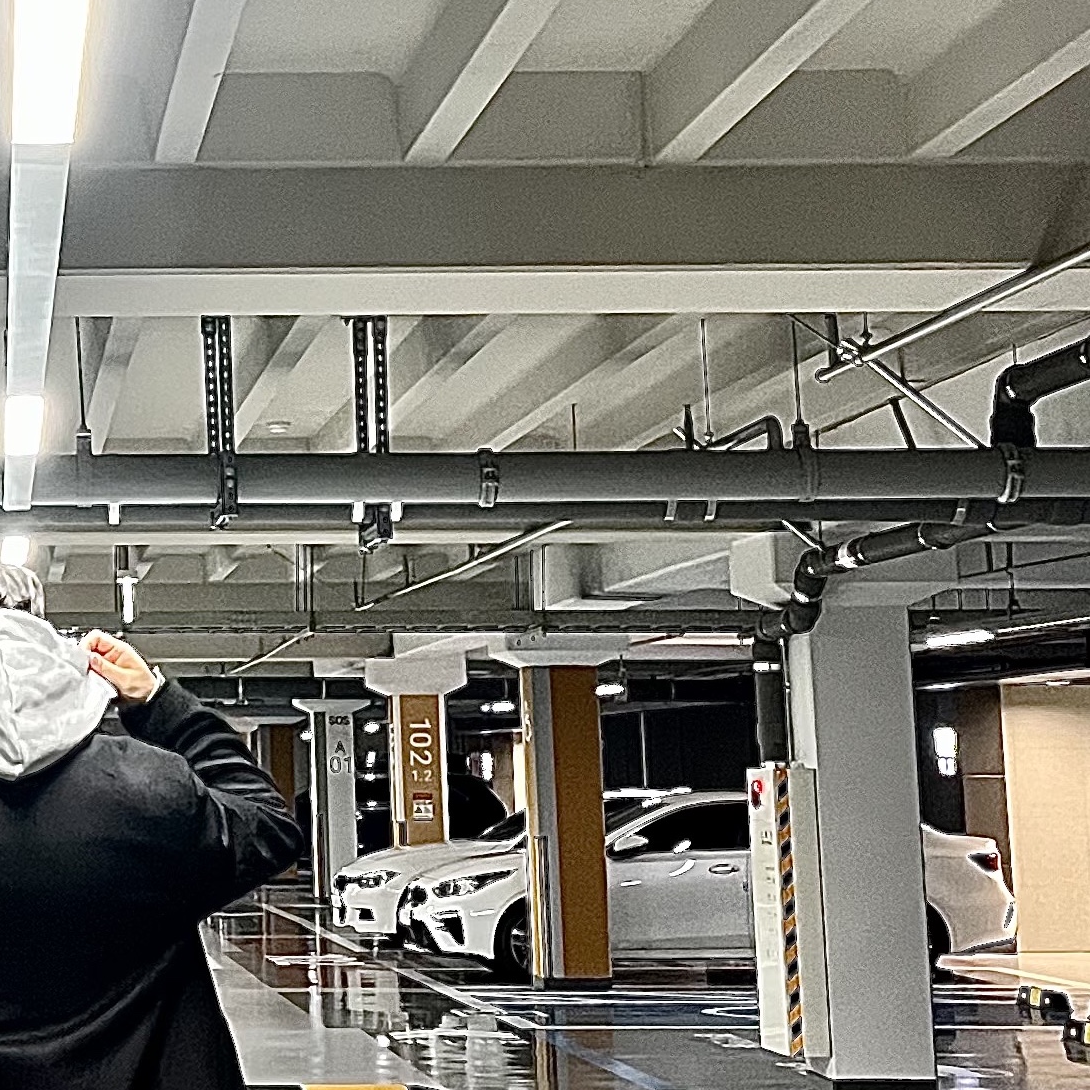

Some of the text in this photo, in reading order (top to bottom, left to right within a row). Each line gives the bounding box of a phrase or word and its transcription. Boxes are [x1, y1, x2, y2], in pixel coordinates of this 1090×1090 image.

[328, 715, 351, 726] SOS
[334, 740, 347, 753] A
[409, 718, 432, 766] 102
[329, 755, 352, 774] 01
[411, 769, 433, 783] 1.2
